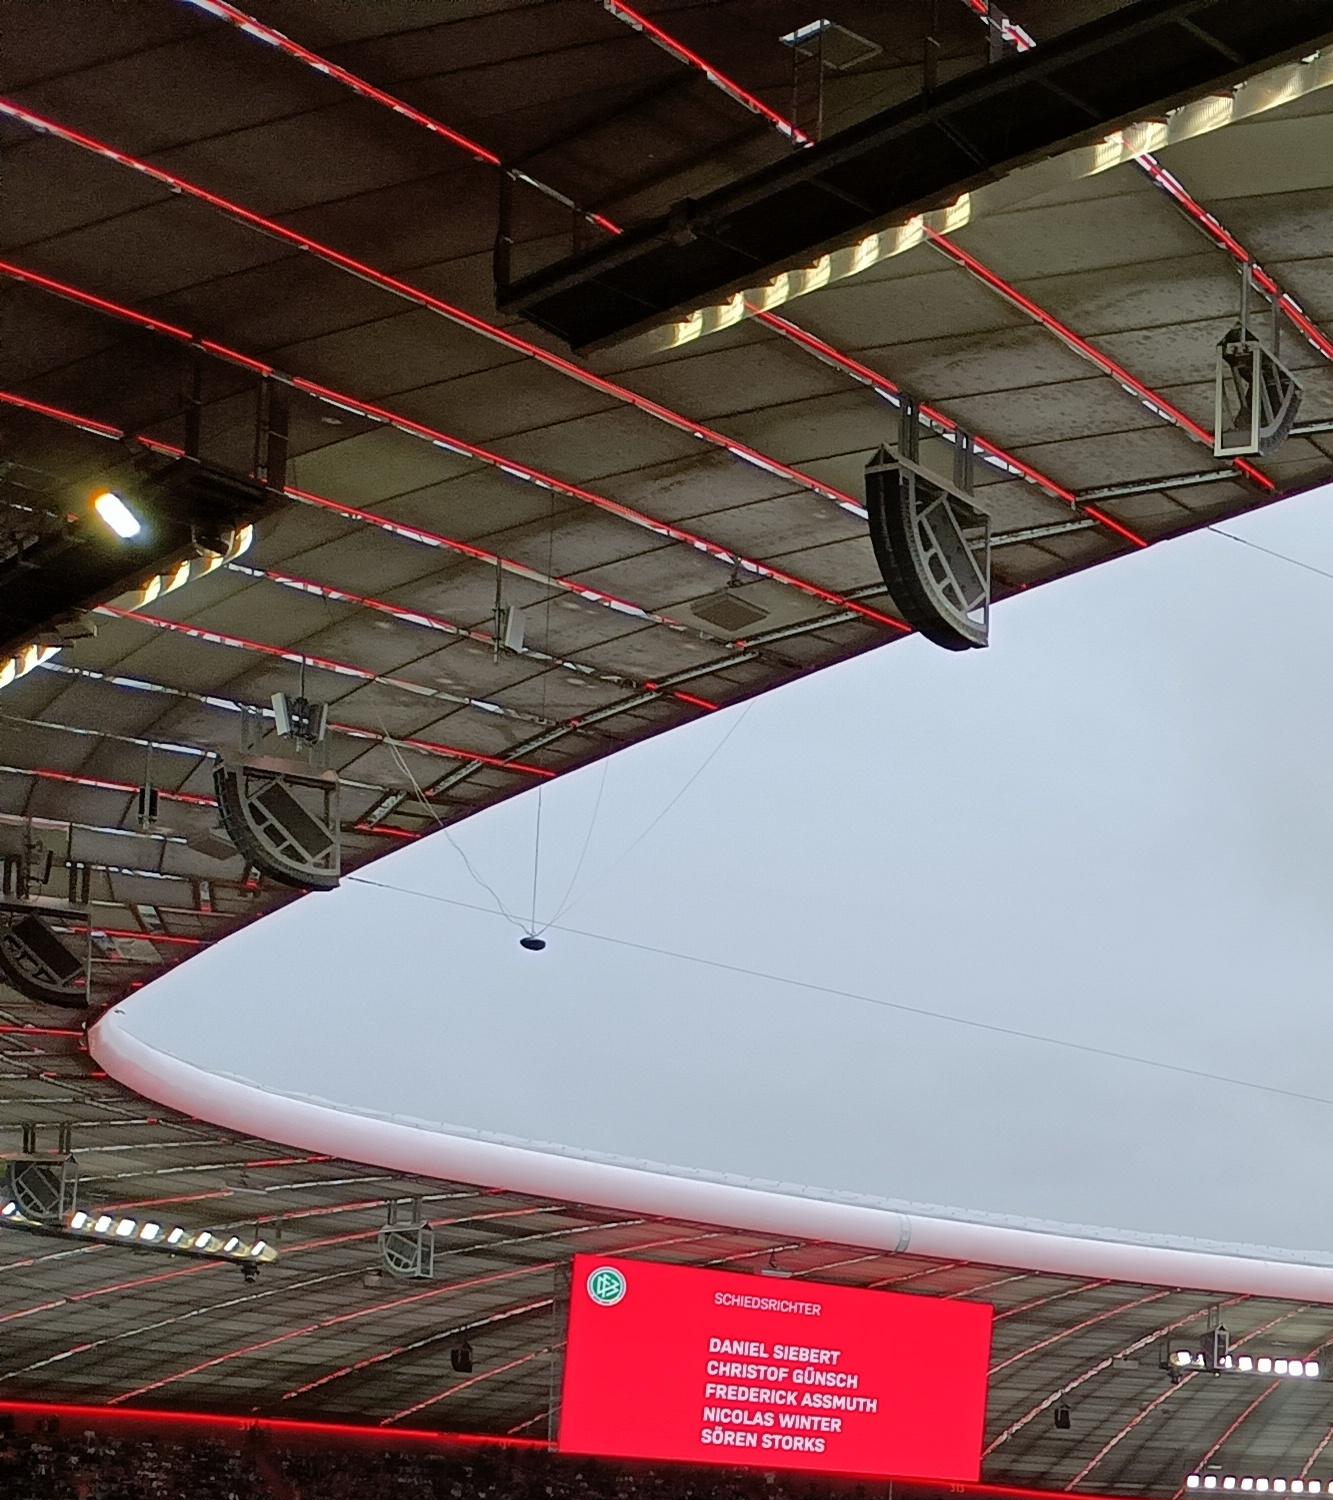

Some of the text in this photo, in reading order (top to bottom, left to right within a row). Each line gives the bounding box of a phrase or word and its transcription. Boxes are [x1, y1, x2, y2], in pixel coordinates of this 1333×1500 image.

[714, 1292, 822, 1316] SCHIEDSRICHTER
[709, 1337, 841, 1365] DANIEL SIEBERT
[707, 1360, 858, 1389] CHRISTOF GÜNSCH
[705, 1383, 878, 1413] FREDERICK ASSMUTH
[703, 1406, 842, 1433] NICOLAS WINTER
[701, 1426, 826, 1453] SÖREN STORKS
